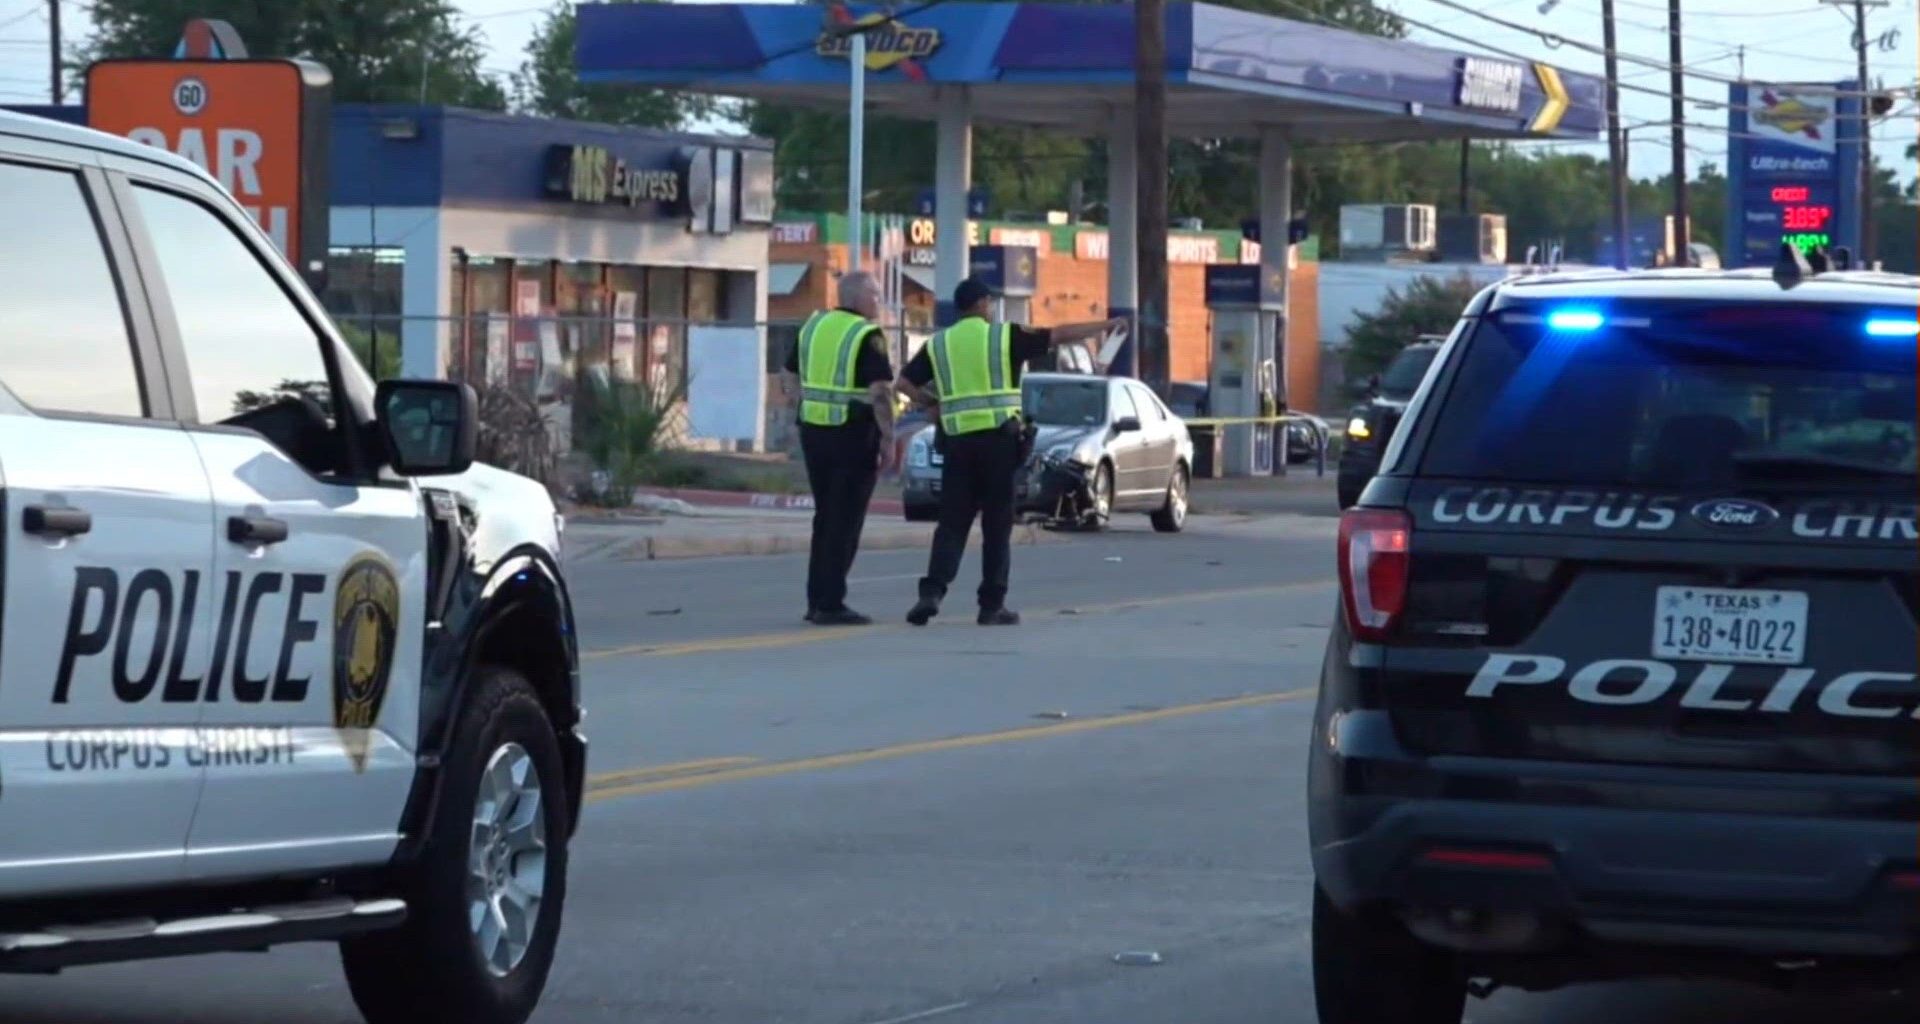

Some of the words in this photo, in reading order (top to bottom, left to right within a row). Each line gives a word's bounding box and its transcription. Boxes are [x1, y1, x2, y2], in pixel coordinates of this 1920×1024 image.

[178, 85, 201, 107] GO
[612, 157, 679, 206] Express
[1167, 236, 1217, 263] PIRITS
[1432, 486, 1676, 531] CORPUS
[1709, 503, 1757, 525] Ford
[1704, 593, 1761, 610] TEXAS
[51, 566, 326, 704] POLICE
[1465, 653, 1919, 719] POLIC
[47, 731, 171, 771] CORPUS
